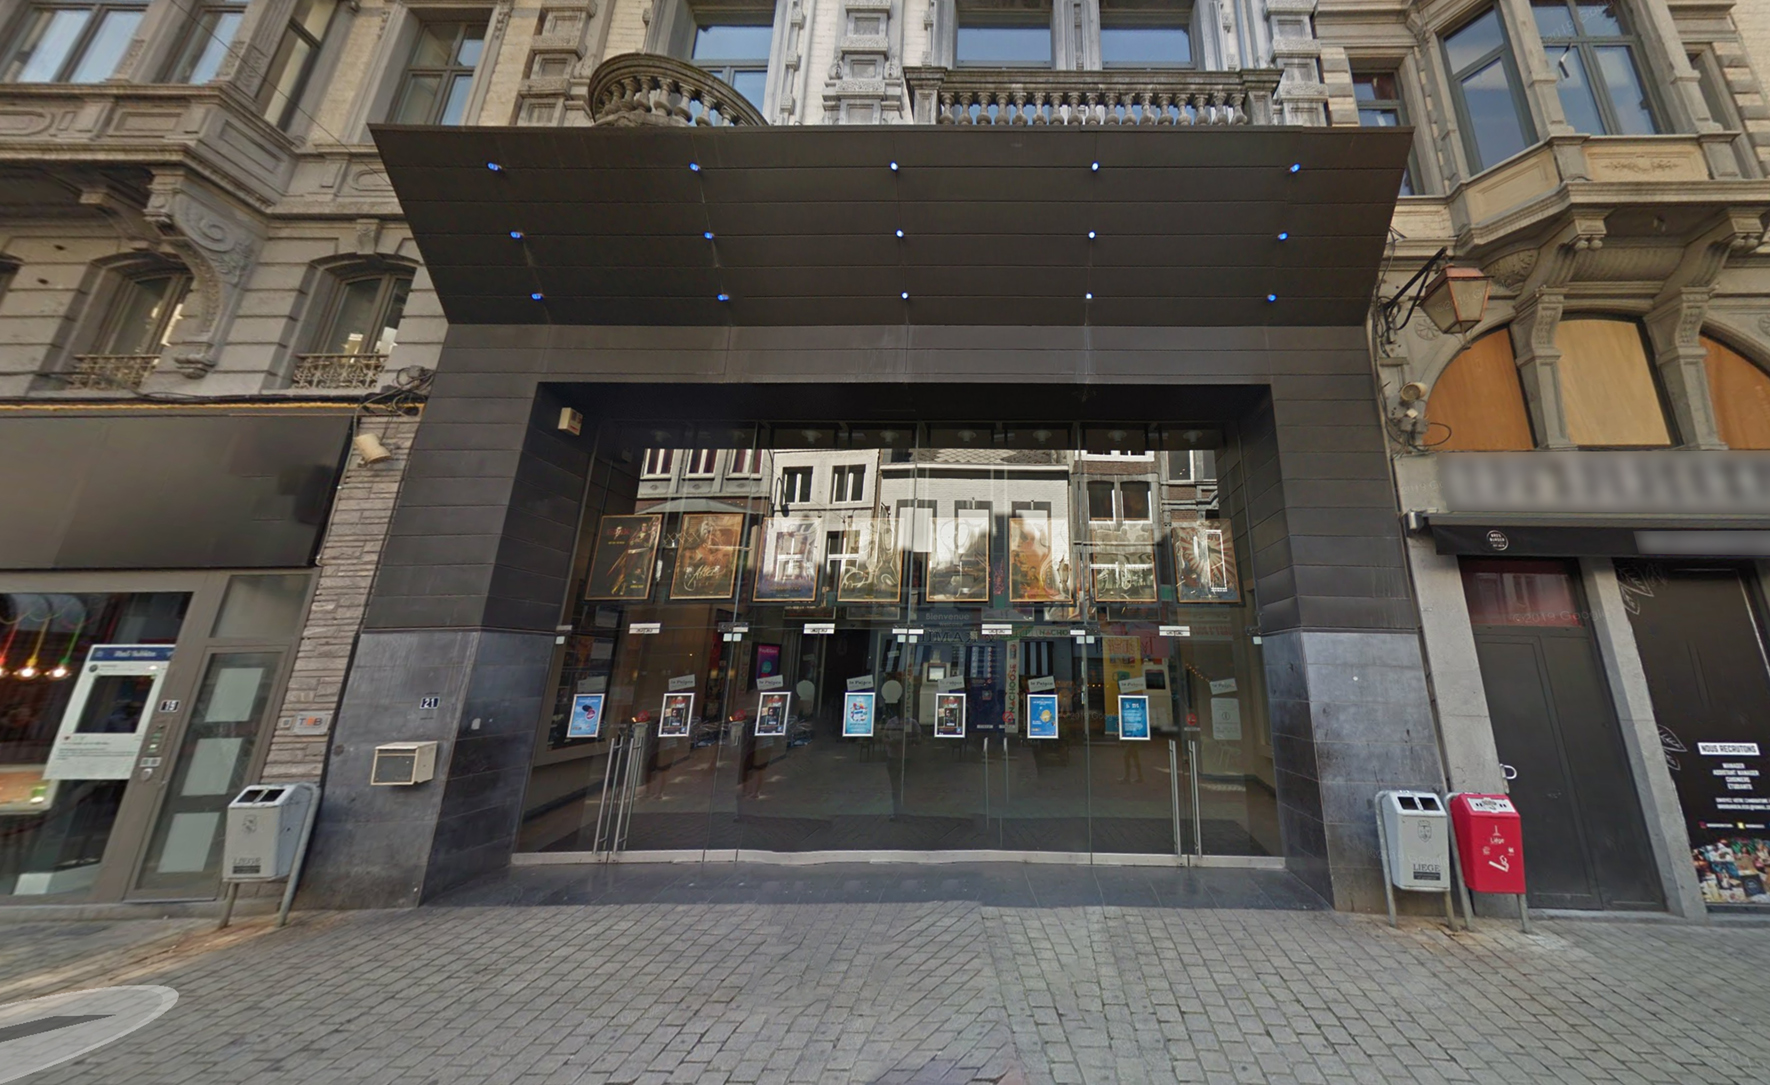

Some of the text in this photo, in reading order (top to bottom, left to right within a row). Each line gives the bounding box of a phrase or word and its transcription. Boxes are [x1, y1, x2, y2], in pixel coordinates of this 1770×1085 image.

[925, 612, 970, 620] Bienvenue
[423, 697, 435, 709] 21
[1701, 745, 1757, 753] NOUS RECRUTONS
[1413, 863, 1441, 872] LIEGE
